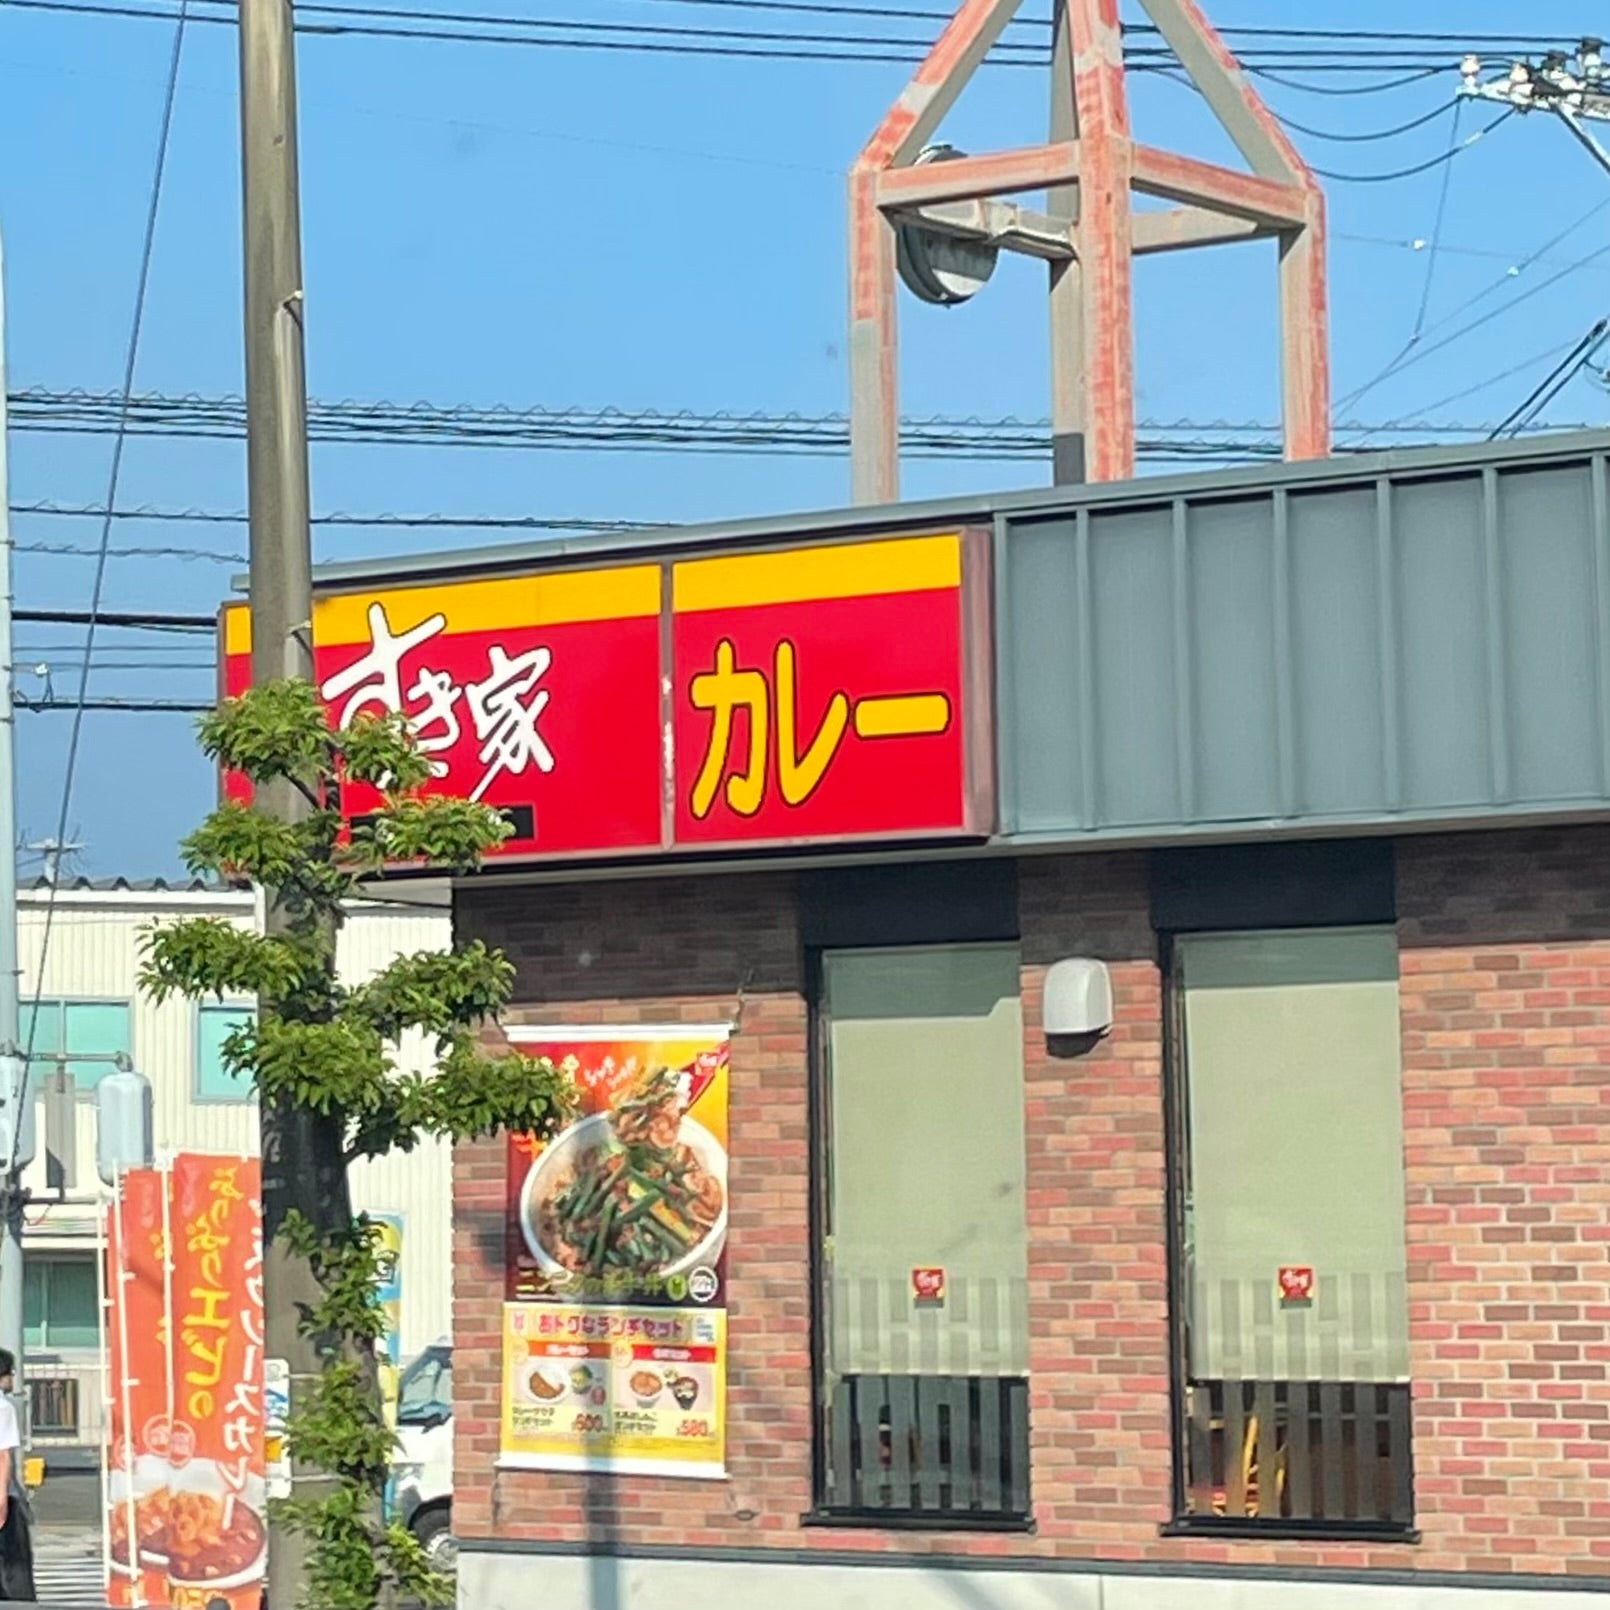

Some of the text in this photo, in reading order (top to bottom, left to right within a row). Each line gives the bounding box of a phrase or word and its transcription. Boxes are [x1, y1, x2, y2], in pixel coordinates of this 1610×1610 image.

[321, 601, 555, 802] すき家
[689, 637, 950, 819] カレー
